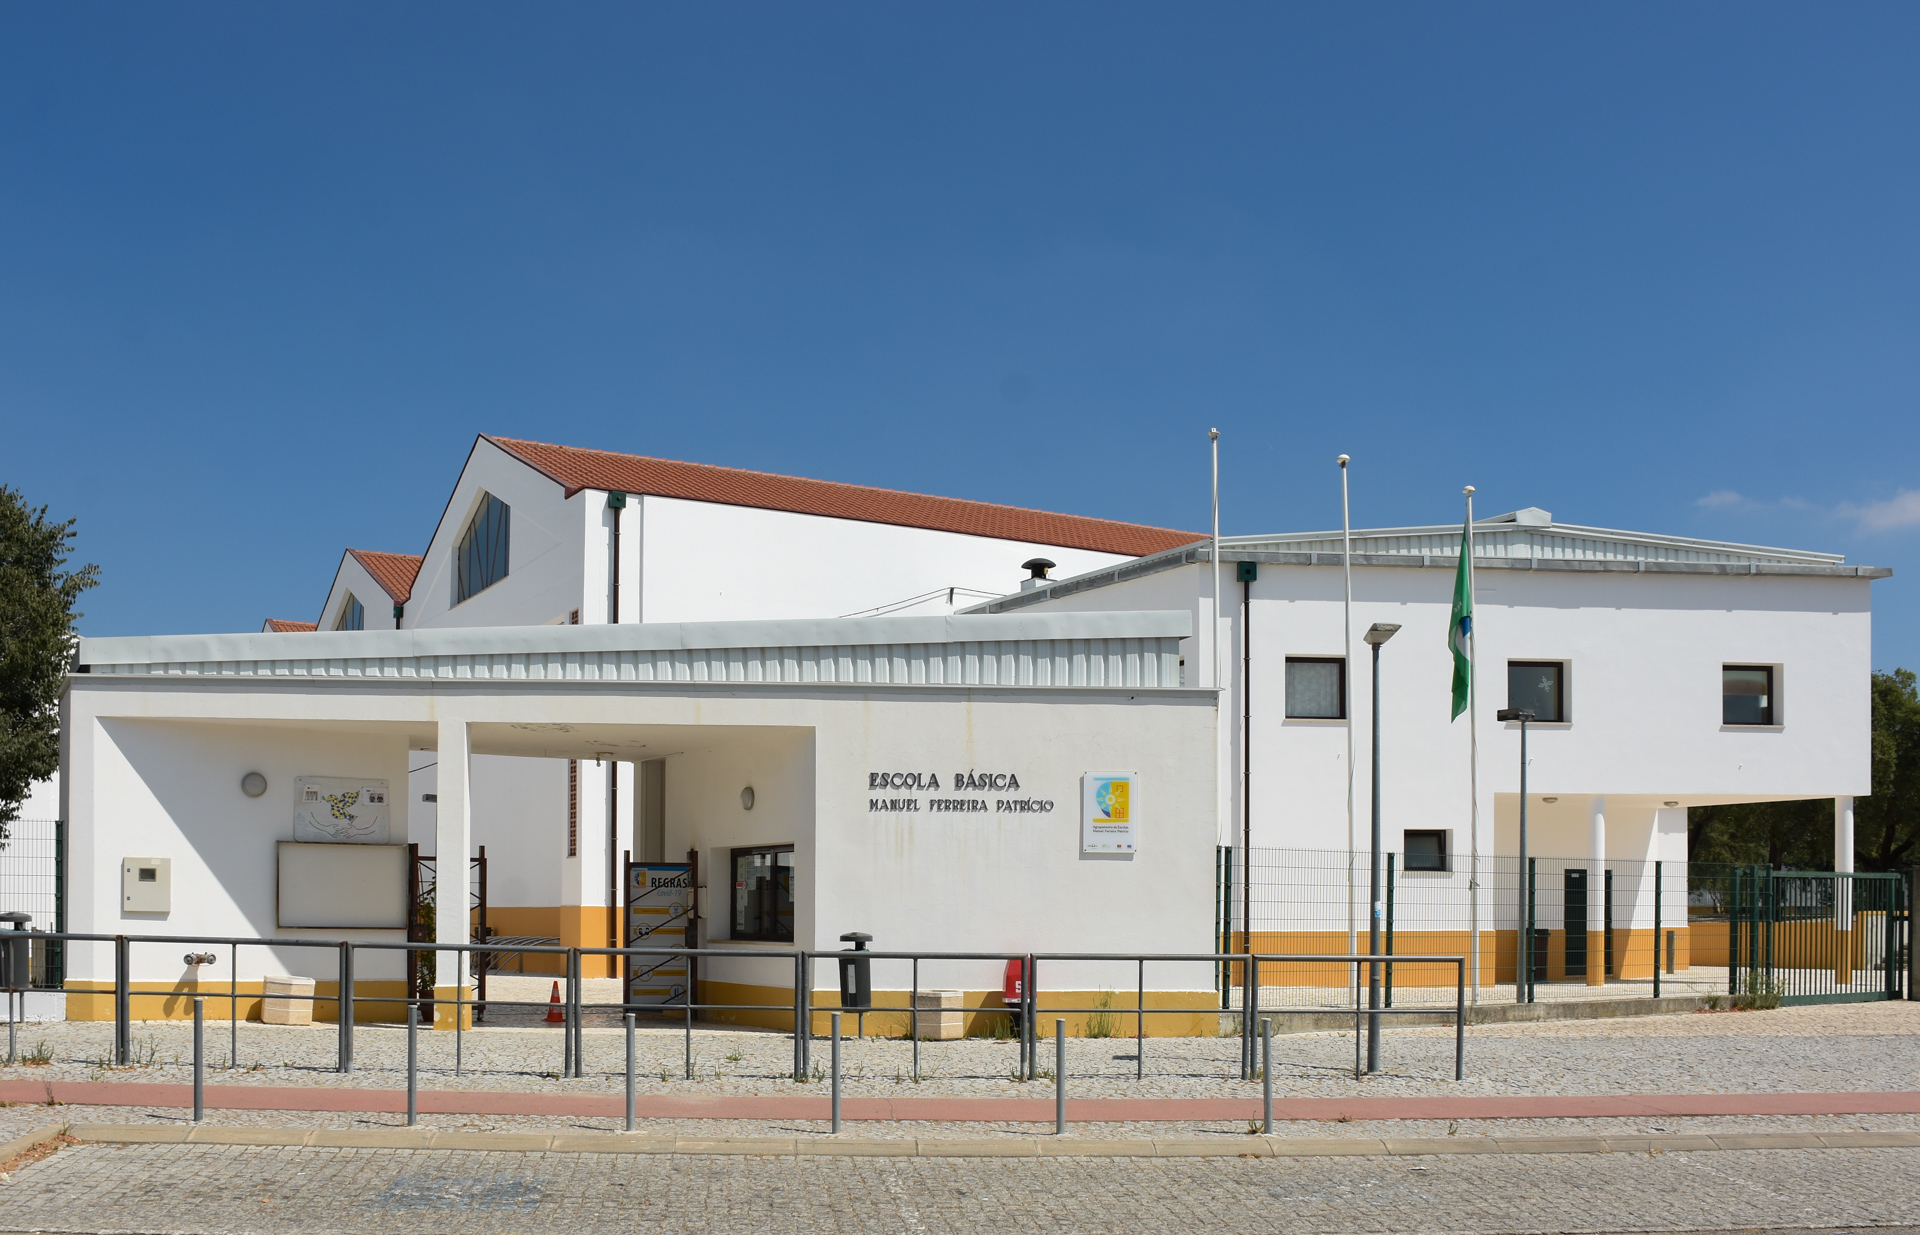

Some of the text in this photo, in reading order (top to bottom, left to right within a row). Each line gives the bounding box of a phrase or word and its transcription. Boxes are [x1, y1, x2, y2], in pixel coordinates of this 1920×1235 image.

[868, 768, 1020, 790] ESCOLA BÁSICA
[869, 797, 1054, 813] MANUEL FERREIRA PATRÍCIO
[651, 877, 688, 889] REGRAS
[656, 889, 682, 897] Covid-19
